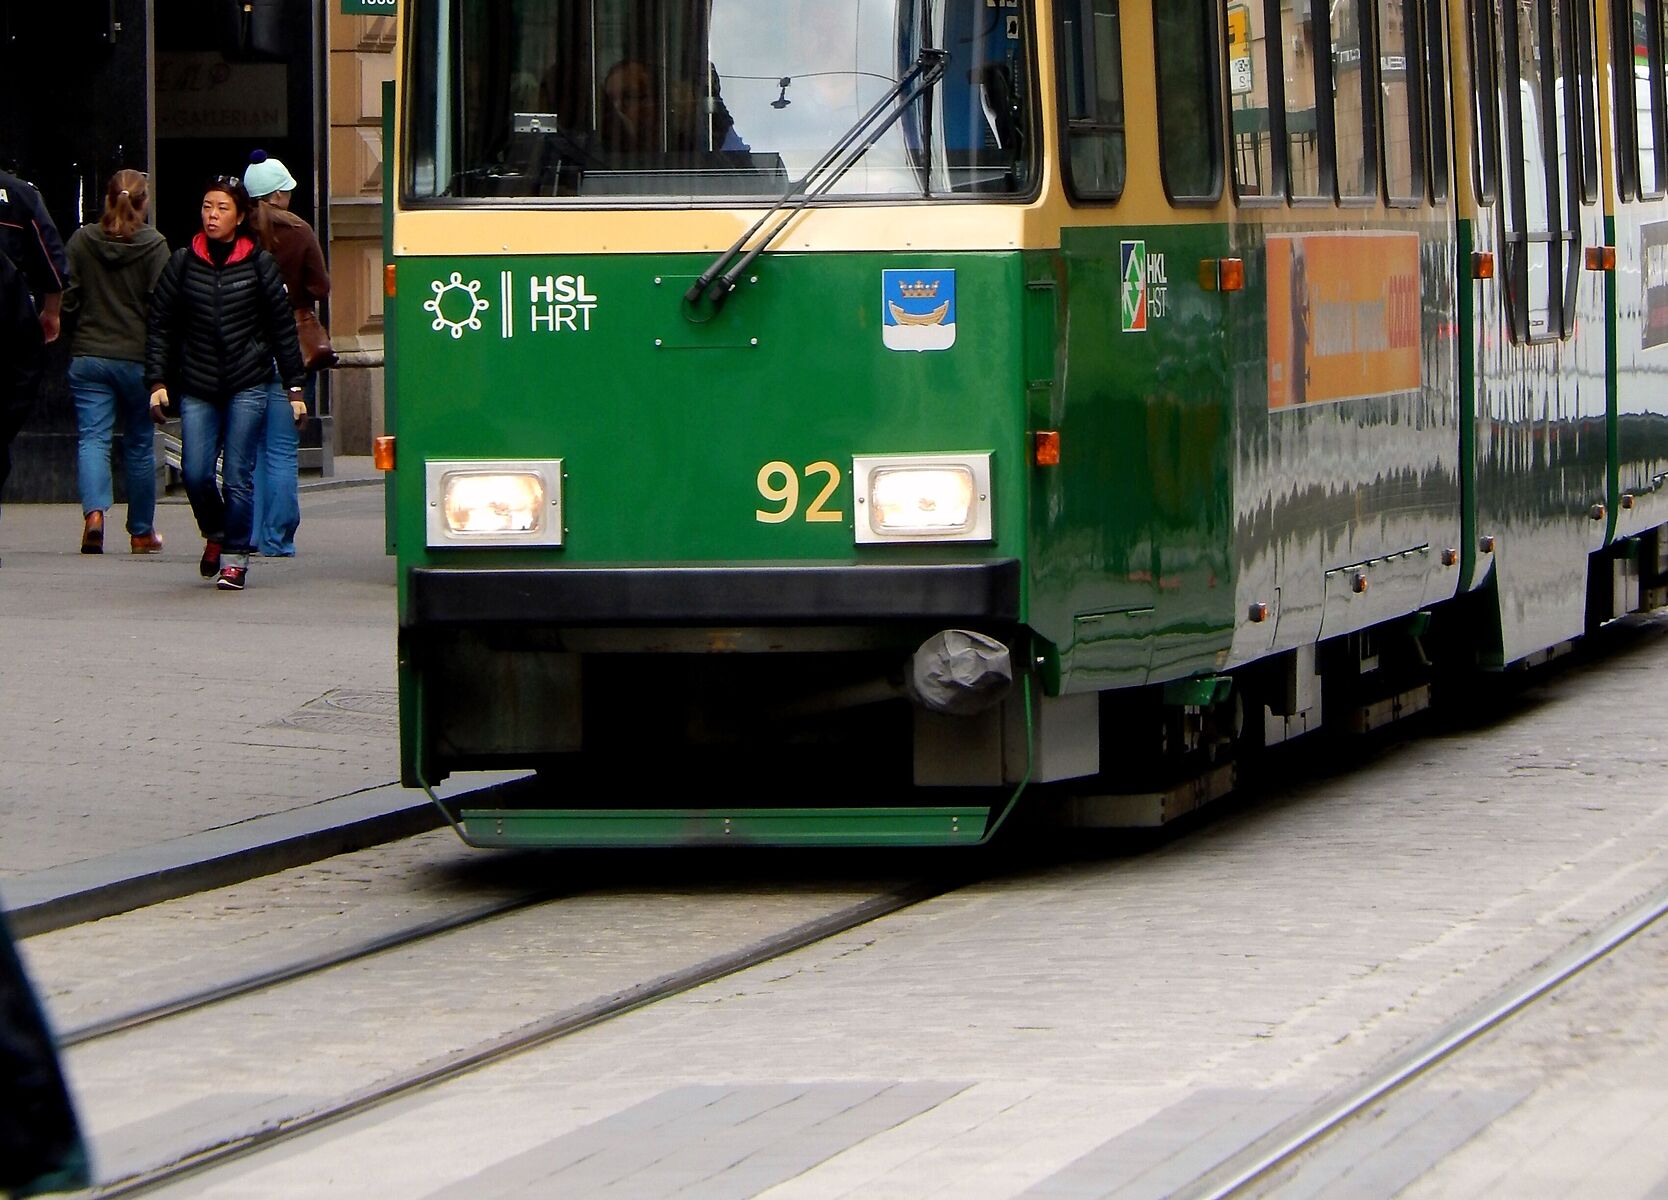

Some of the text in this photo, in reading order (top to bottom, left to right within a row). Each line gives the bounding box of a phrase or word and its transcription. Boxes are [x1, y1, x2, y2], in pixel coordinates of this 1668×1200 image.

[1146, 252, 1168, 284] HKL
[529, 274, 598, 303] HSL
[1147, 286, 1168, 318] HST
[530, 303, 598, 332] HRT
[754, 460, 844, 524] 92
